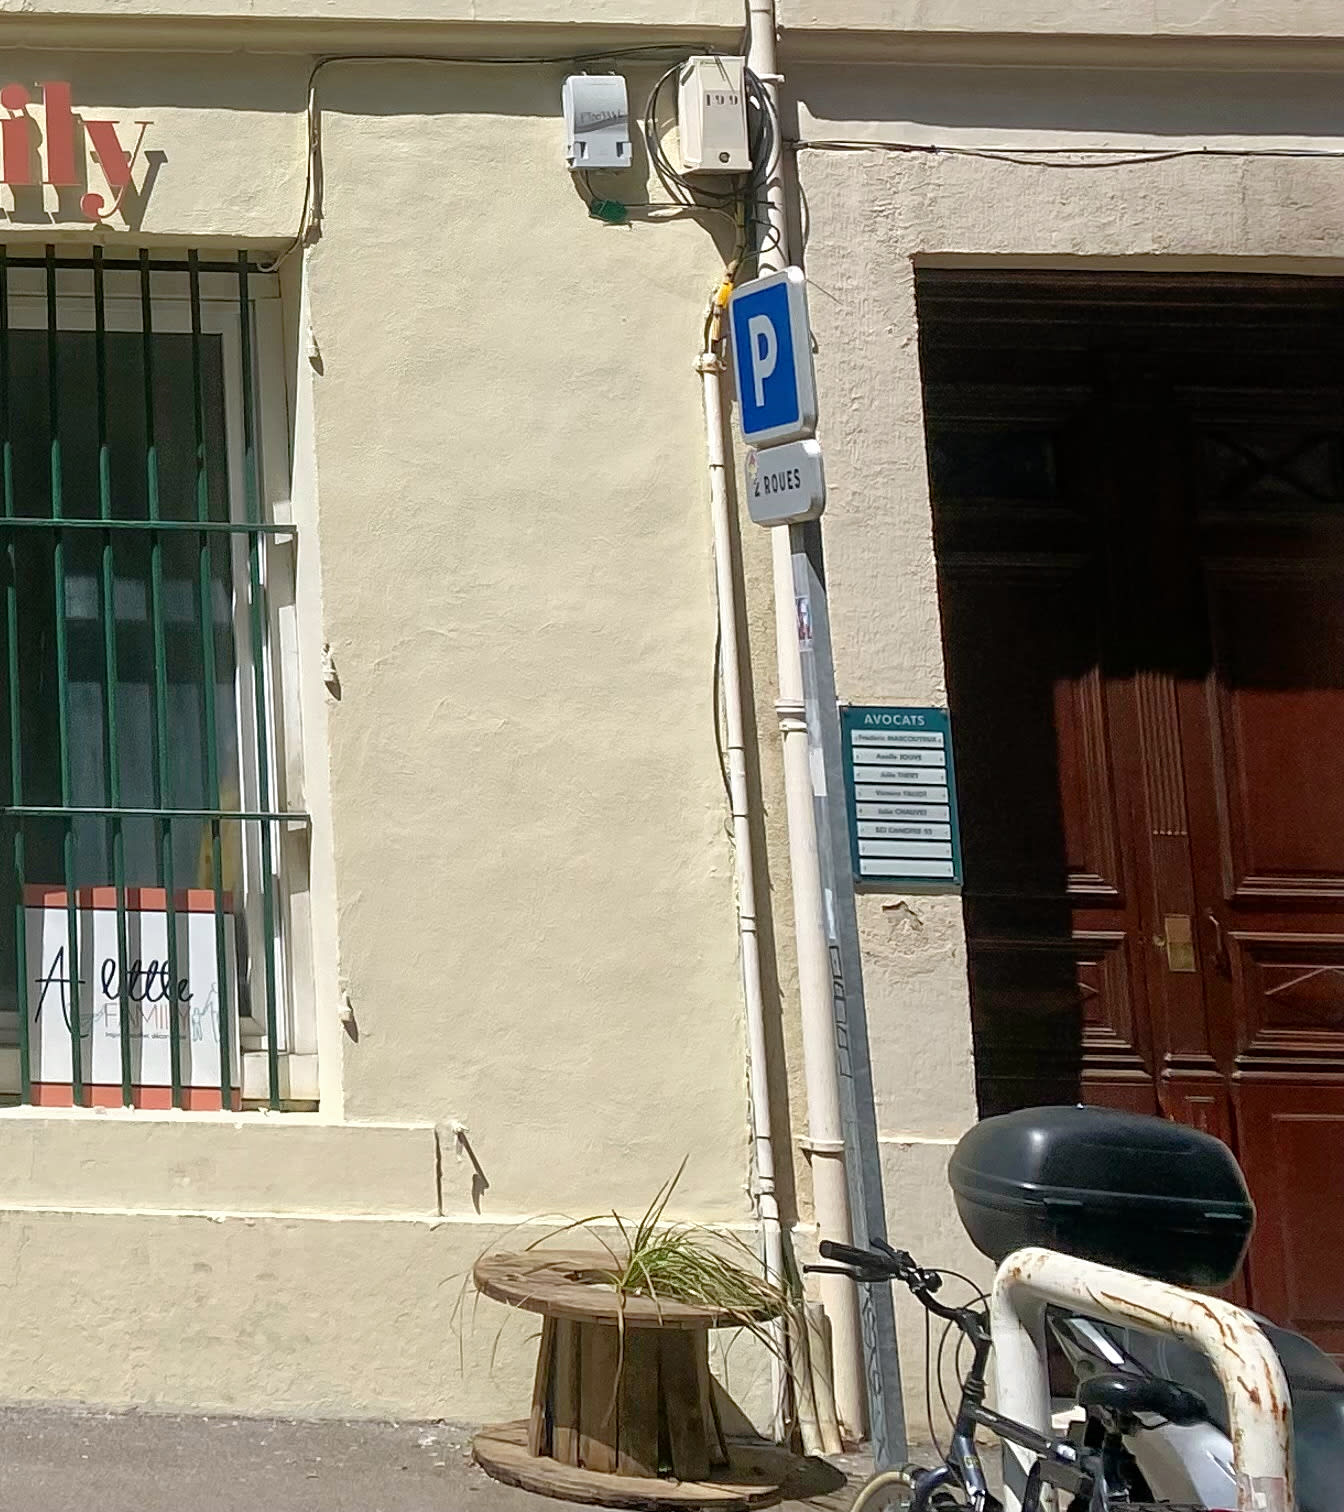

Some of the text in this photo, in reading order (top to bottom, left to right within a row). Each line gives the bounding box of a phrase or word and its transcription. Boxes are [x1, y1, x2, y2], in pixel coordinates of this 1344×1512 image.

[748, 314, 778, 407] P
[764, 468, 801, 495] ROUES
[864, 713, 926, 727] AVOCATS
[35, 946, 194, 1037] A lttle
